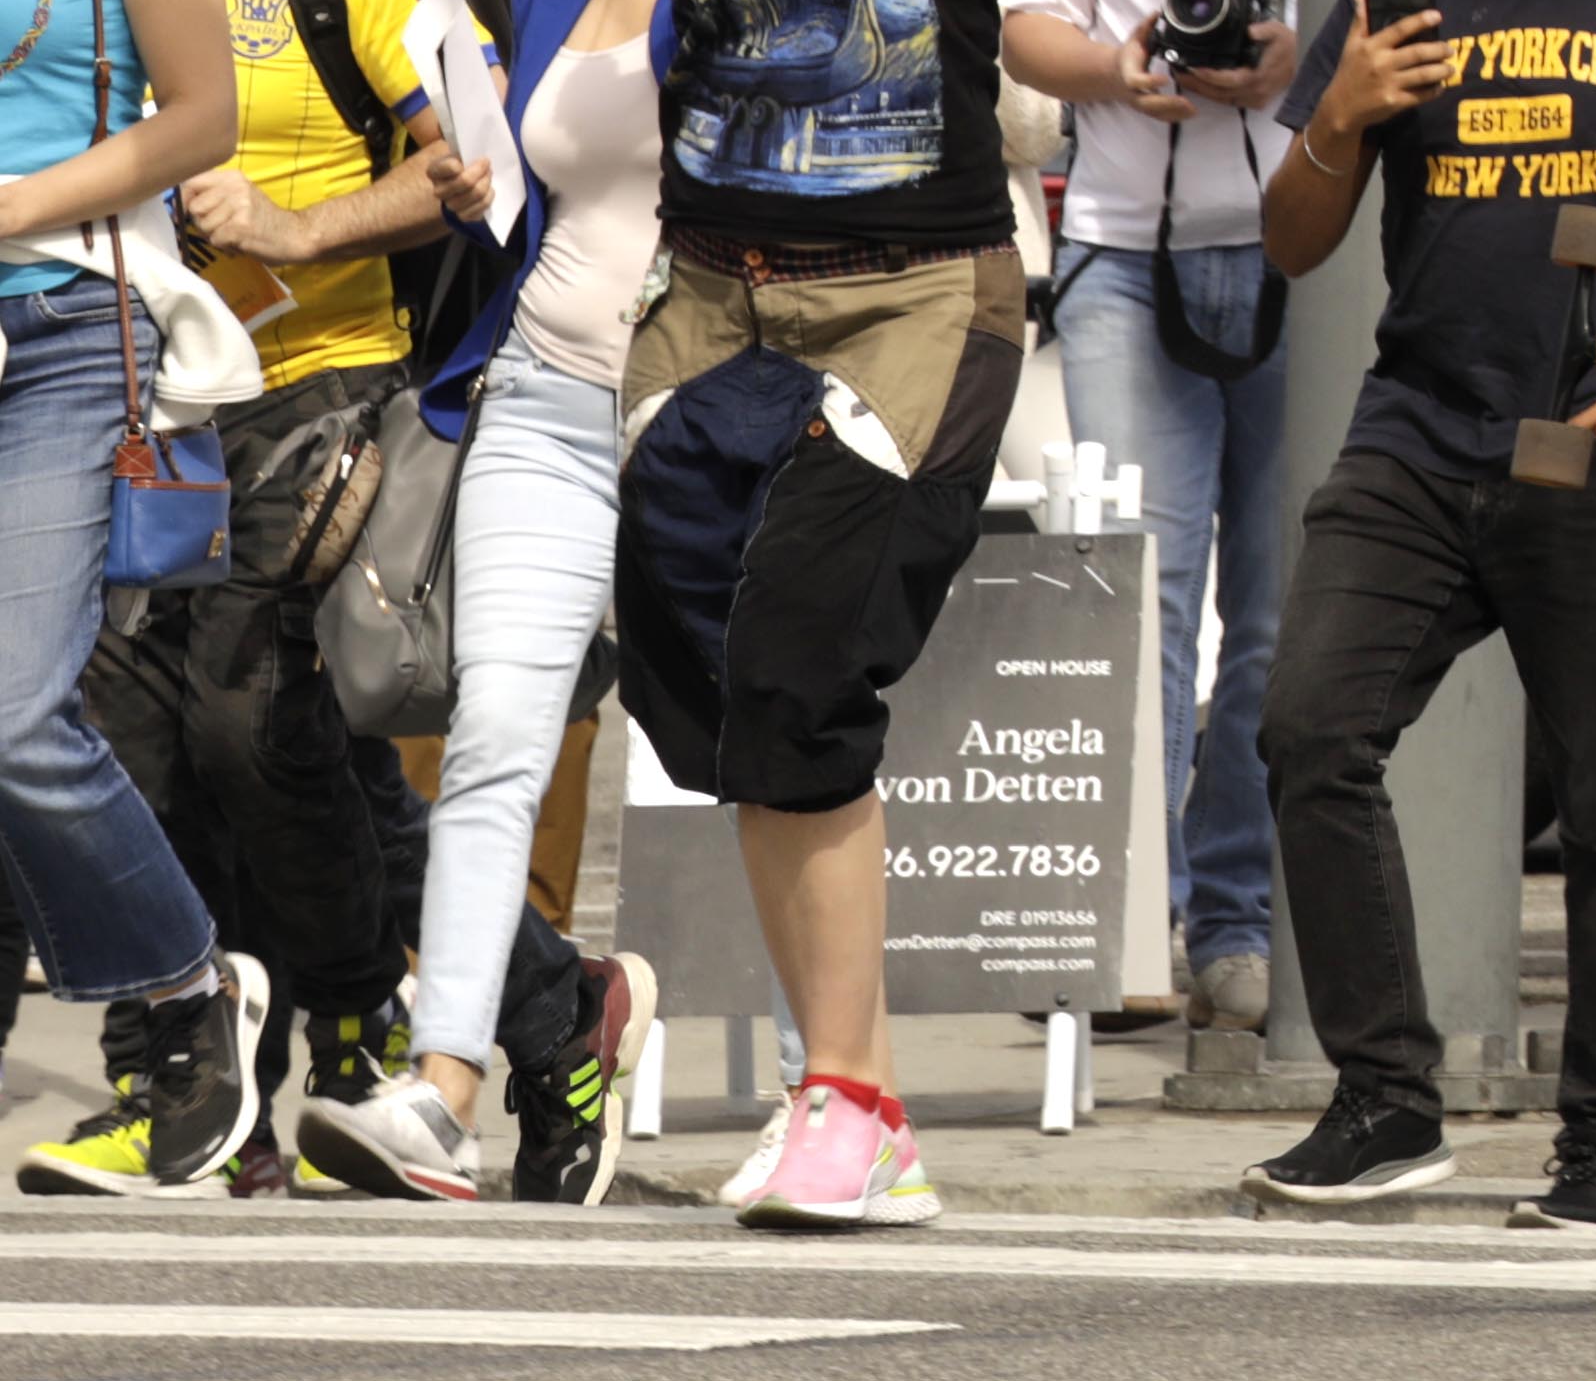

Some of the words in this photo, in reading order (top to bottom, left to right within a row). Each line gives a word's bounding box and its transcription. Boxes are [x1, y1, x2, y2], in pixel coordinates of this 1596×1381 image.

[1477, 26, 1571, 81] YORK
[1519, 106, 1565, 132] 1664
[1424, 154, 1506, 199] NEW
[996, 659, 1046, 677] OPEN
[1051, 659, 1112, 677] HOUSE
[957, 718, 1105, 764] Angela
[875, 774, 952, 804] von
[963, 767, 1103, 804] Detten
[979, 909, 1017, 927] DRE
[980, 957, 1096, 975] compass.com
